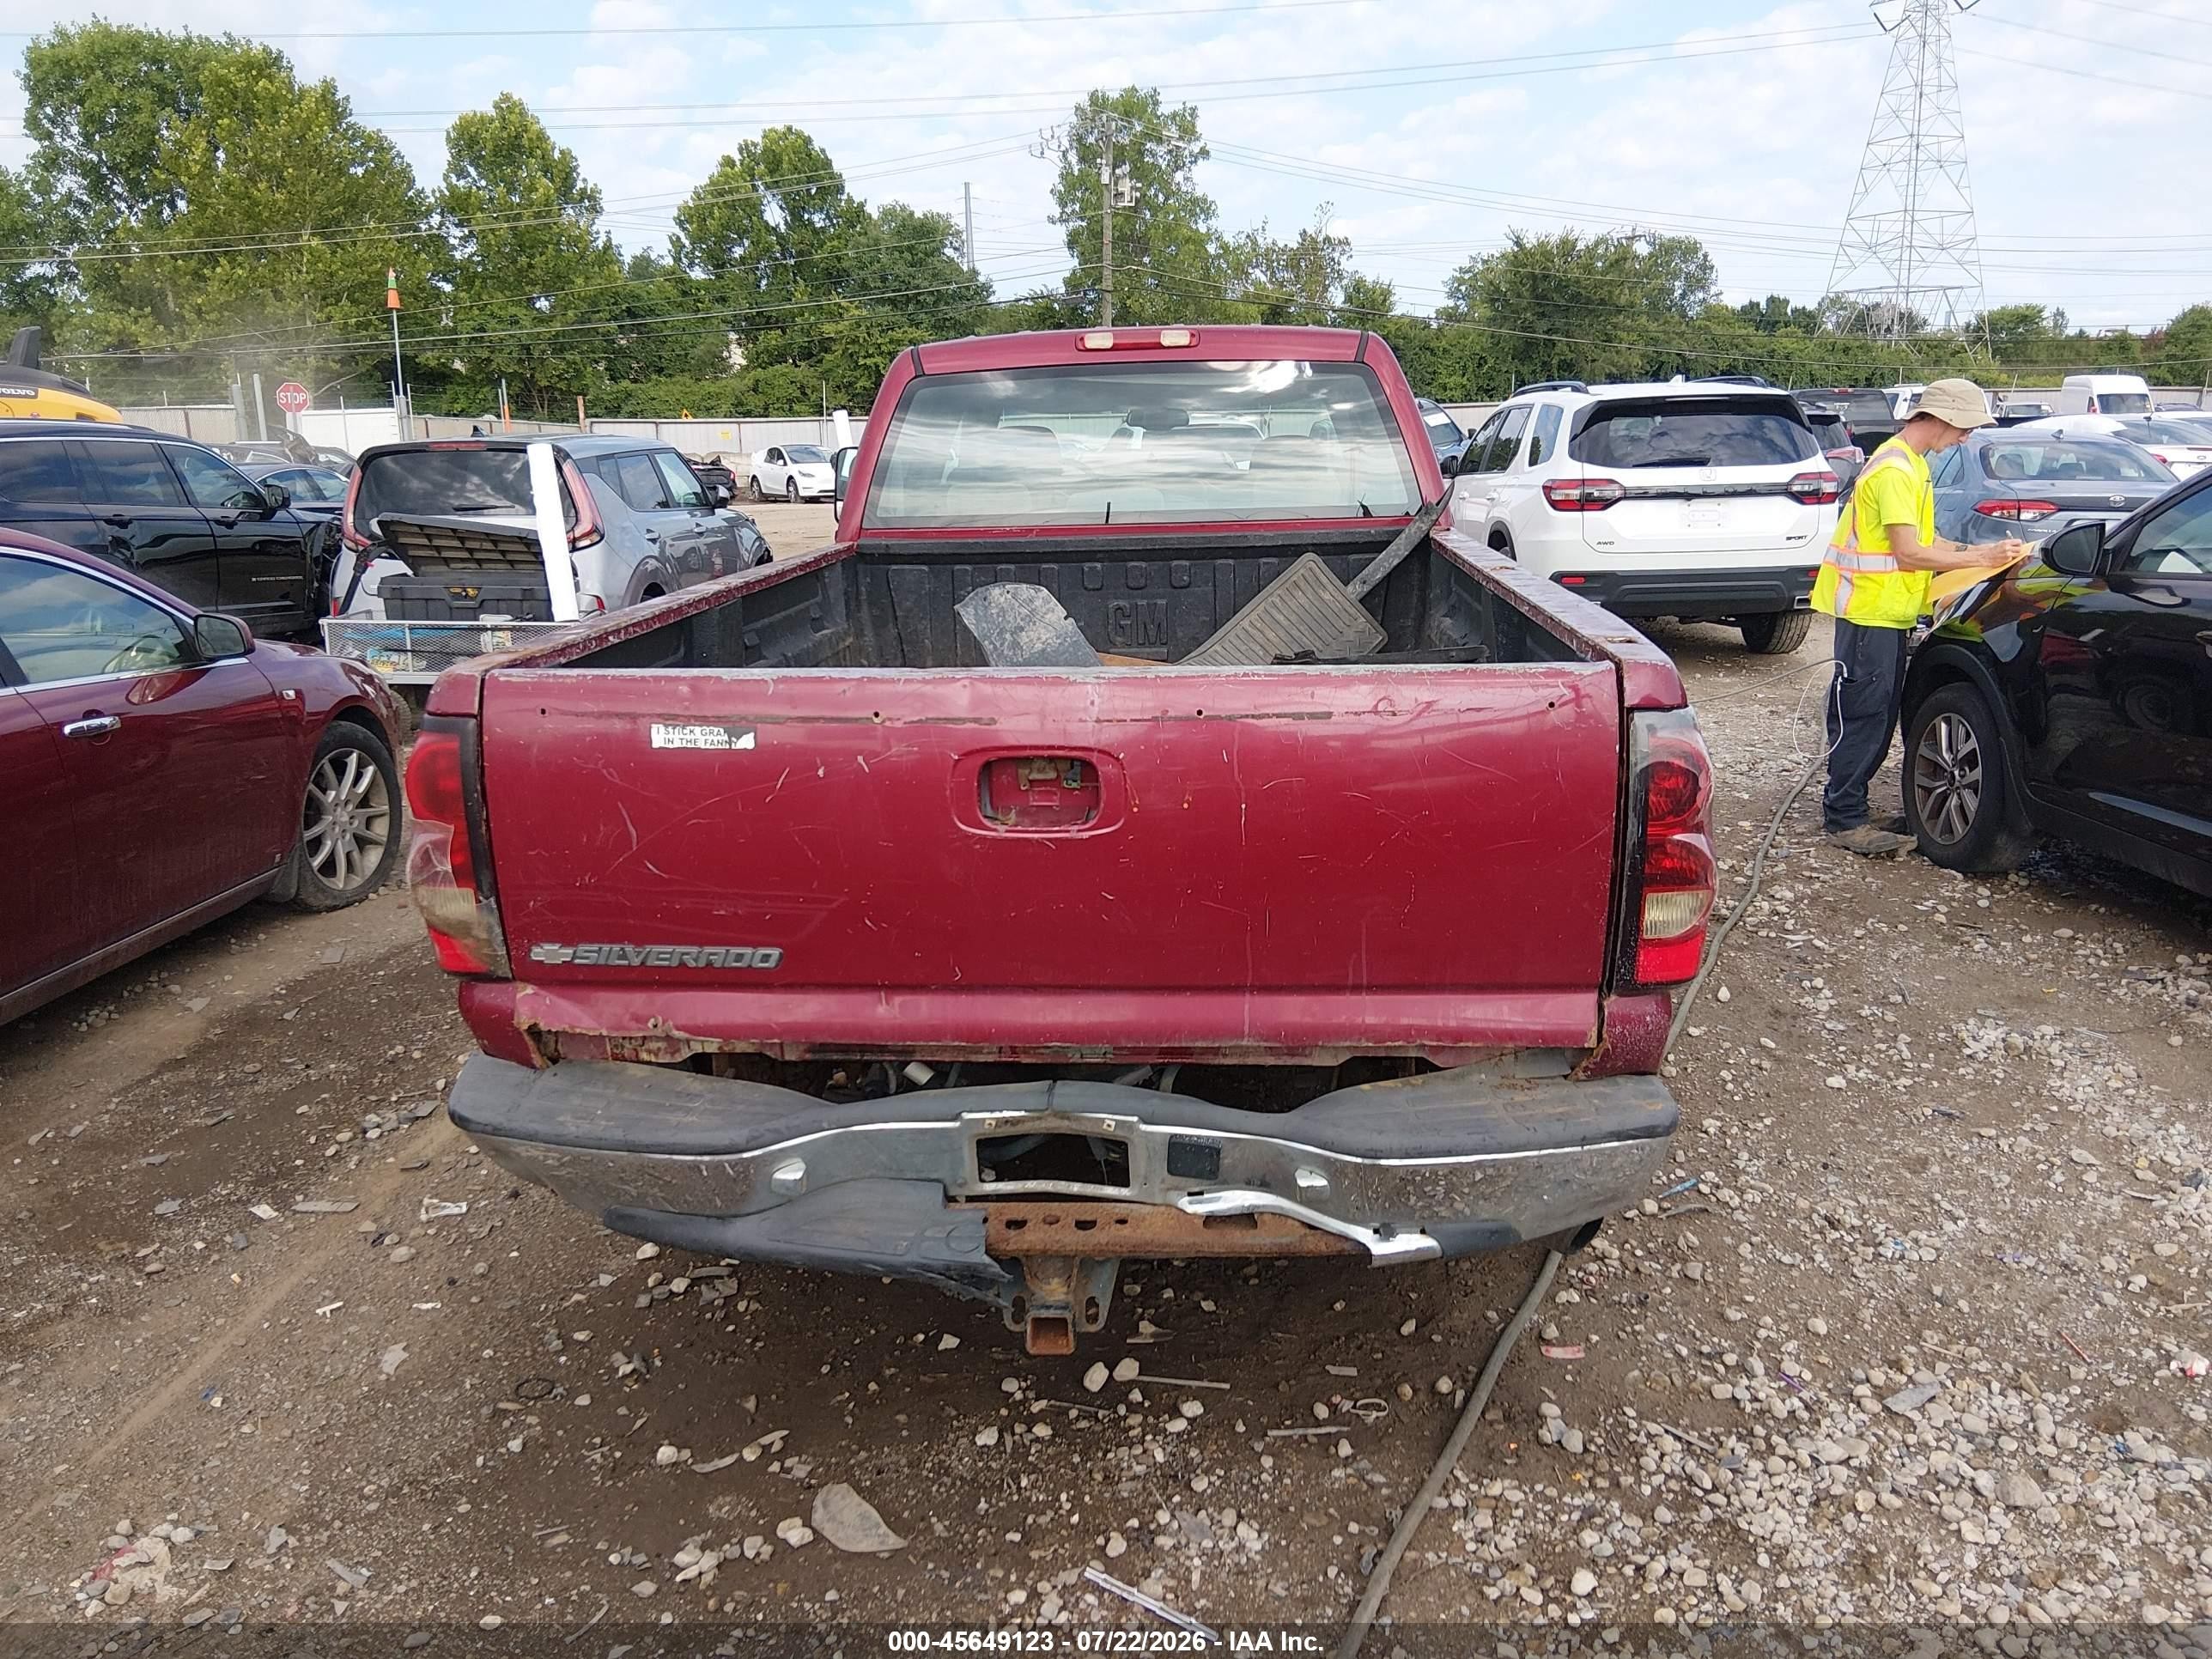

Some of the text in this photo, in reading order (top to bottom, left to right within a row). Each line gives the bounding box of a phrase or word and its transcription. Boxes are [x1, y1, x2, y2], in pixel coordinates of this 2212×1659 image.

[279, 392, 307, 404] STOP
[1107, 601, 1168, 647] GM
[664, 727, 696, 736] STICK
[664, 737, 674, 745] IN
[679, 738, 700, 746] THE
[574, 945, 782, 968] SILVERADO
